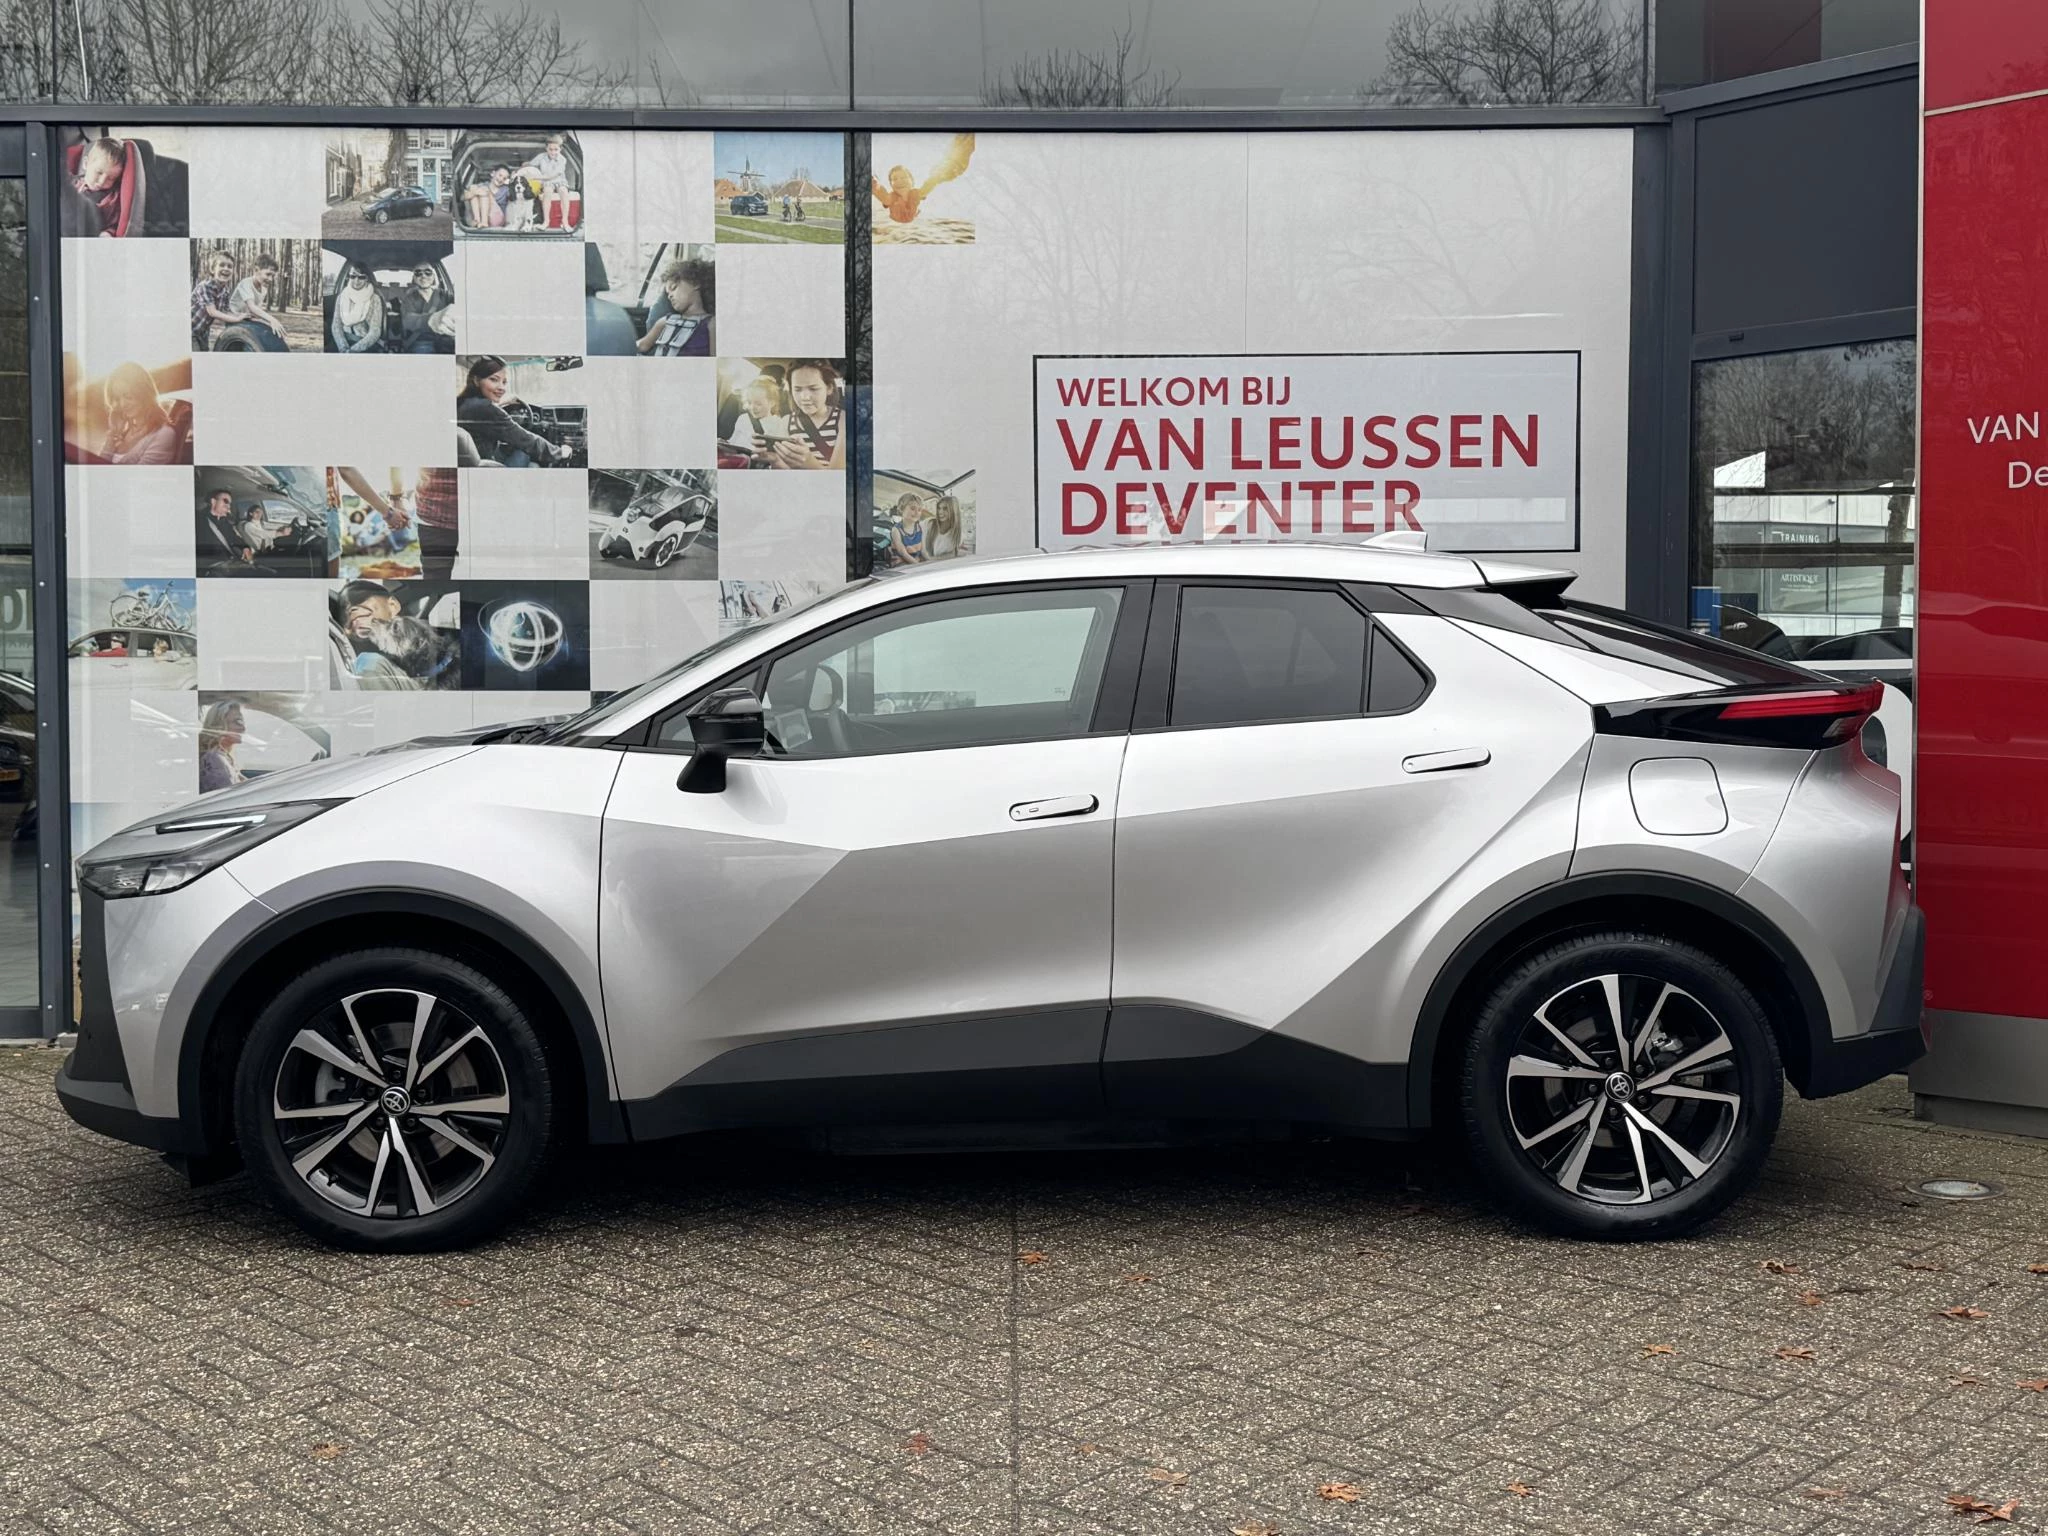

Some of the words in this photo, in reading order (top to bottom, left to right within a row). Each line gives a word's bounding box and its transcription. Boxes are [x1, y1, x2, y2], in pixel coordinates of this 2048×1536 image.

[1057, 377, 1229, 407] WELKOM
[1242, 376, 1291, 406] BIJ
[1056, 418, 1205, 472] VAN
[1231, 414, 1539, 470] LEUSSEN
[1967, 411, 2040, 444] VAN
[1061, 480, 1422, 535] DEVENTER
[1780, 533, 1820, 543] TRAINING
